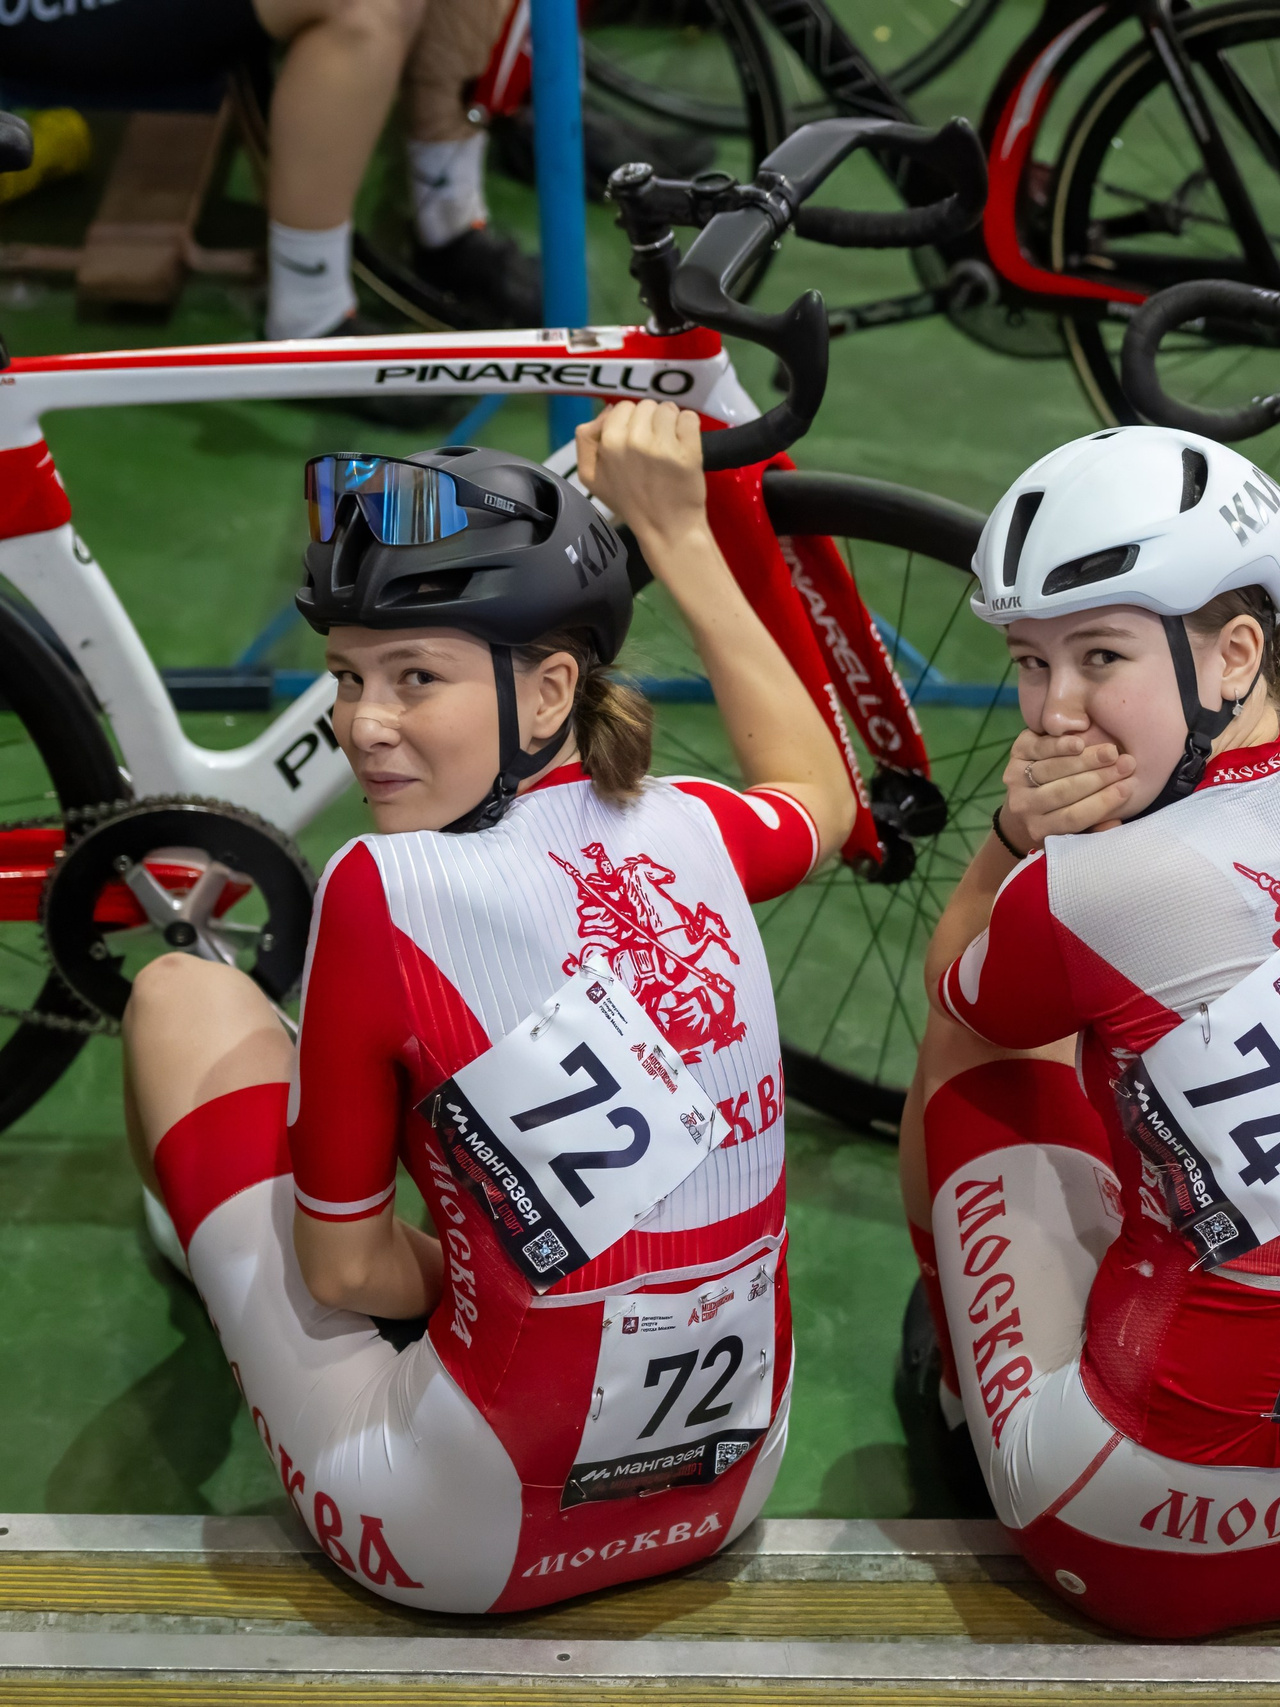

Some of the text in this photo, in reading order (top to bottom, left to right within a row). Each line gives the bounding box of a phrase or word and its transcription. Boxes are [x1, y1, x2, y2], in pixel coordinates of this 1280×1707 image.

[374, 361, 695, 396] PINARELLO
[991, 596, 1022, 611] KASK
[509, 1041, 651, 1208] 72
[1147, 1110, 1214, 1209] мангазея
[465, 1132, 542, 1226] мангазея
[425, 1142, 478, 1350] МОСКВА
[955, 1174, 1036, 1450] МОСКВА
[636, 1335, 744, 1441] 72
[613, 1445, 706, 1477] мангазея
[521, 1512, 723, 1578] МОСКВА
